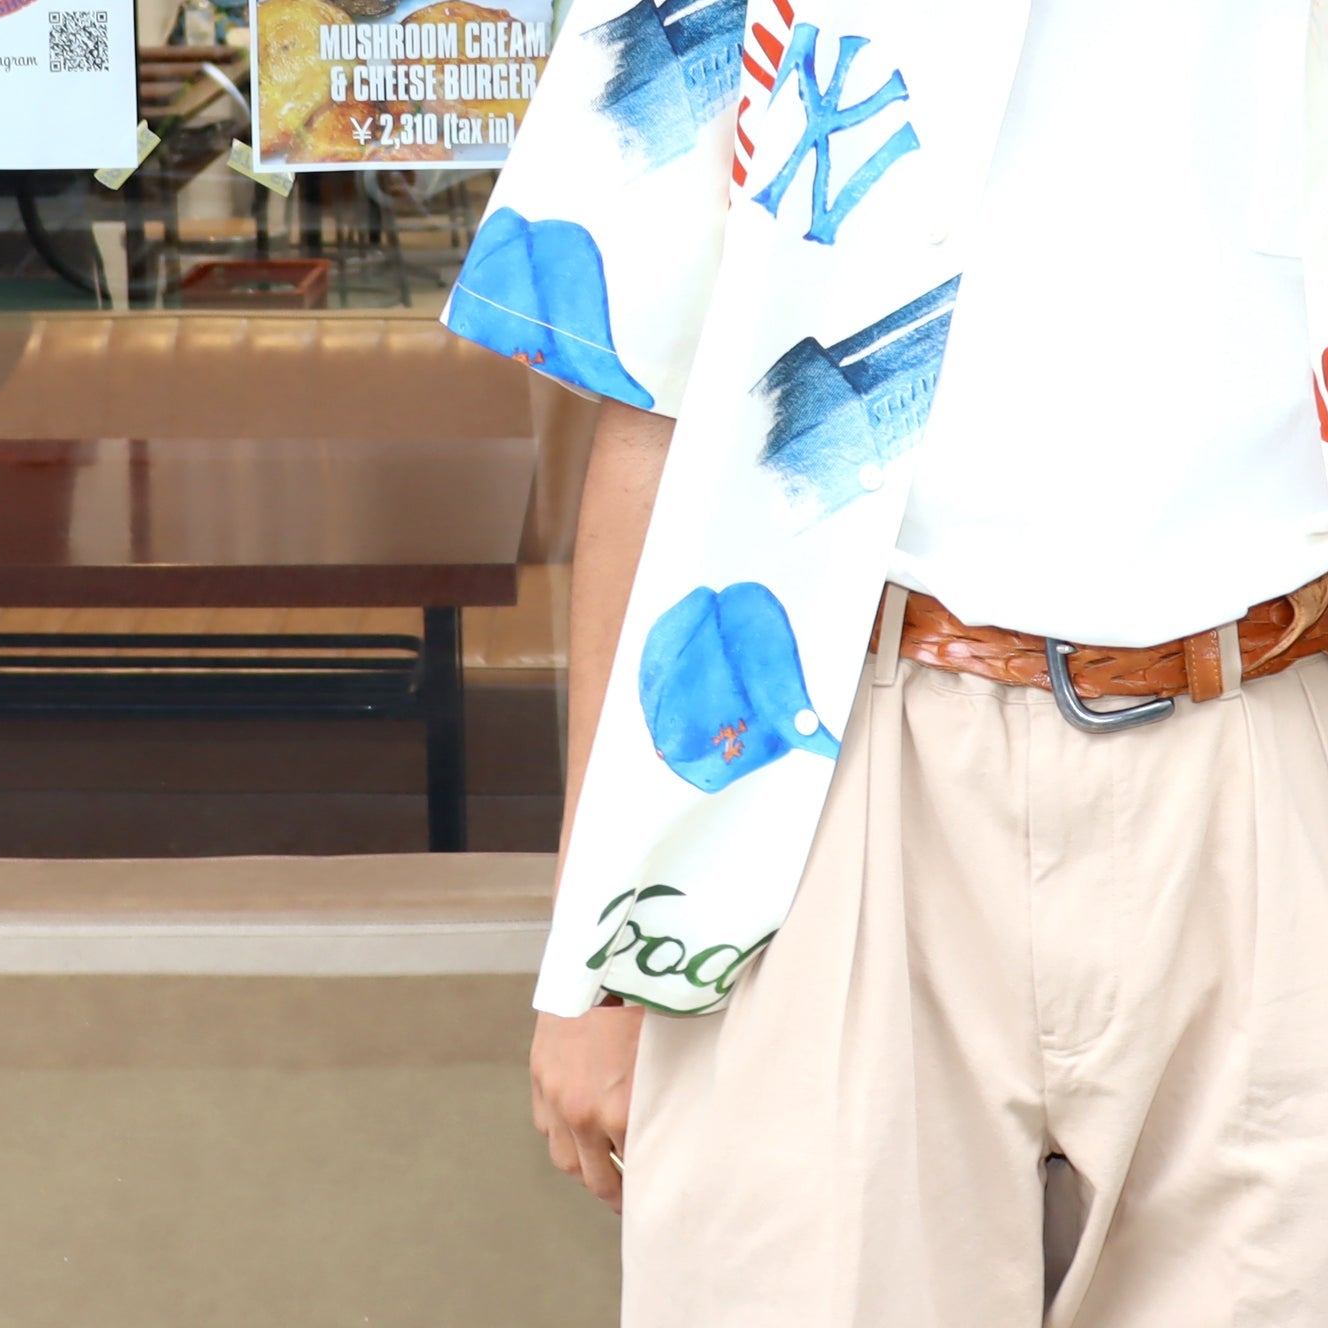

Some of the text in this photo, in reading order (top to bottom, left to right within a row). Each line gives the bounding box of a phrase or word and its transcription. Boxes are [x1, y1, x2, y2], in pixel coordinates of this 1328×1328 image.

[320, 23, 459, 60] MUSHROOM
[330, 63, 538, 102] & CHEESE BURGER
[351, 112, 516, 149] ¥ 2,310 (tax in)
